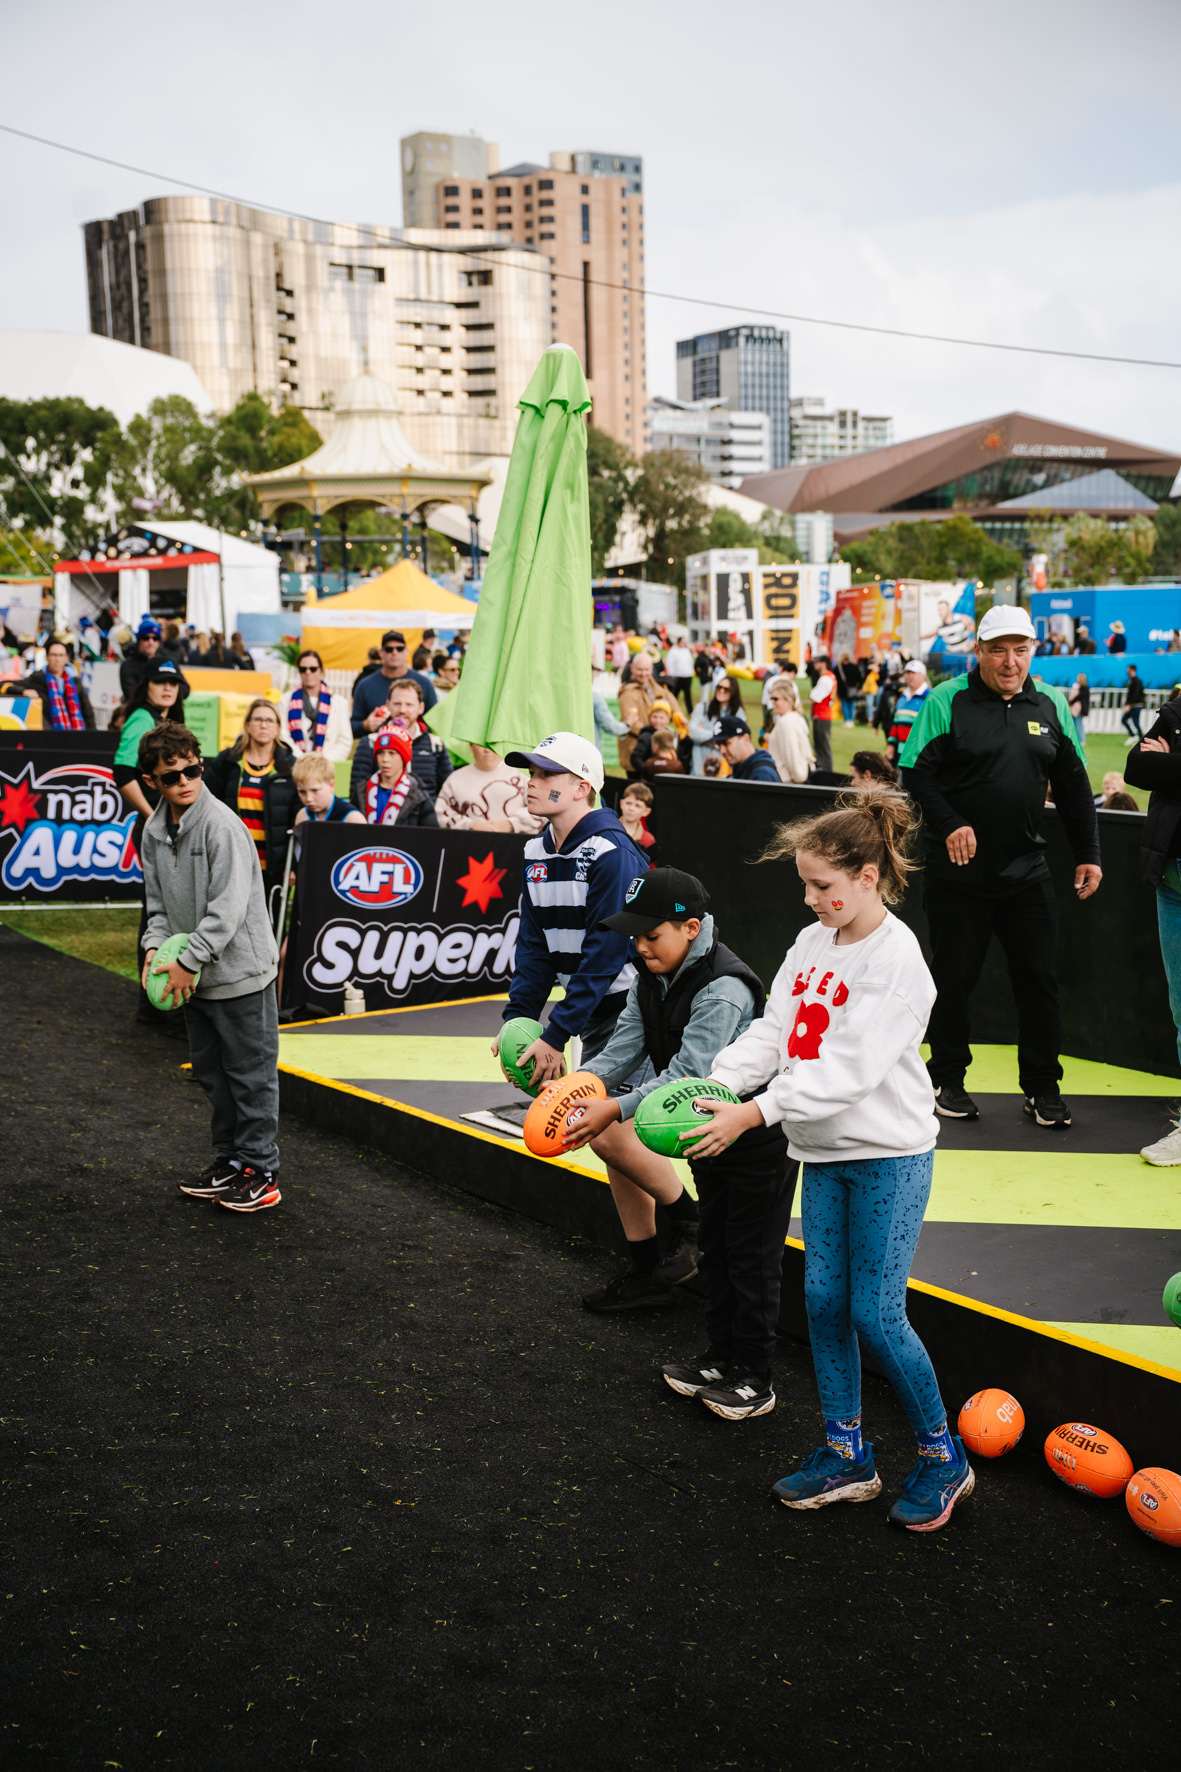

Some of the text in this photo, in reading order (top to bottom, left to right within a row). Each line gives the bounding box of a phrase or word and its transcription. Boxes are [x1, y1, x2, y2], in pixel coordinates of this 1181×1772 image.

[46, 785, 116, 821] nab
[338, 861, 414, 894] AFL
[527, 866, 548, 879] AFL
[544, 1083, 597, 1139] SHERRIN
[1142, 1493, 1158, 1508] AFL
